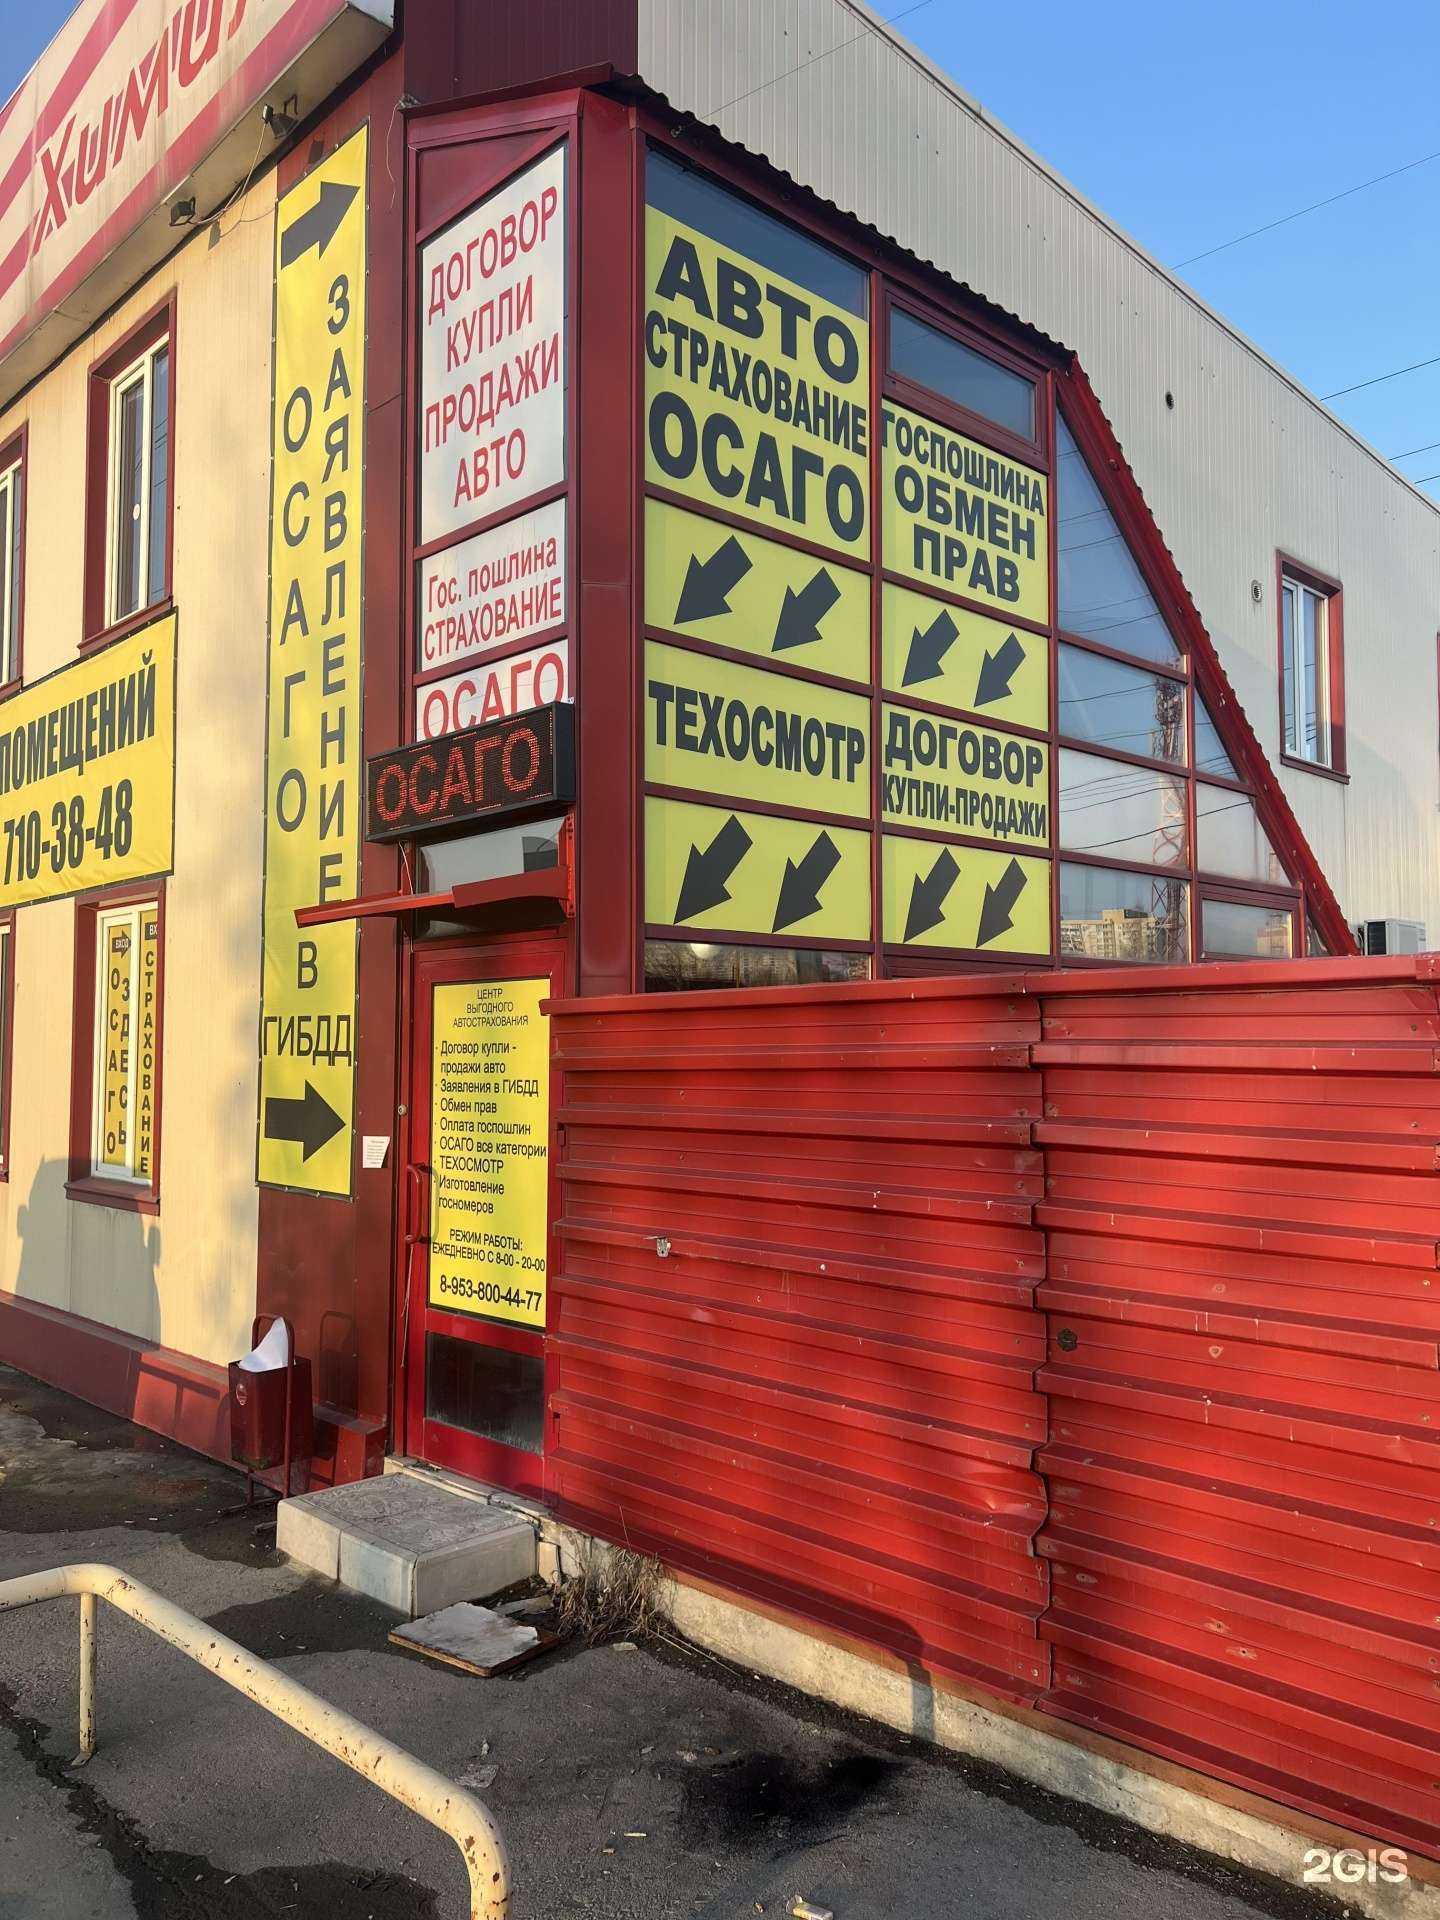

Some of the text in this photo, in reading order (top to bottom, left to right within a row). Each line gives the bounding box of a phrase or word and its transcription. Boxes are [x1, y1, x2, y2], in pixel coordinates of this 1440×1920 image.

[428, 186, 558, 325] ДОГОВОР
[446, 275, 533, 372] КУПЛИ
[654, 235, 859, 385] АВТО
[425, 332, 560, 453] ПРОДАЖИ
[645, 310, 867, 457] СТРАХОВАНИЕ
[454, 428, 526, 507] АВТО
[648, 391, 864, 542] ОСАГО
[881, 408, 1045, 516] ГОСПОШЛИНА
[894, 464, 1036, 560] ОБМЕН
[428, 536, 557, 613] Гос. пошлина
[913, 524, 1020, 603] ПРАВ
[276, 385, 313, 833] ОСАГО
[424, 577, 562, 661] СТРАХОВАНИЕ
[0, 650, 156, 795] ПОМЕЩЕНИЙ
[423, 653, 564, 739] ОСАГО
[648, 680, 865, 783] ТЕХОСМОТР
[376, 727, 540, 821] ОСАГО
[885, 712, 1043, 788] ДОГОВОР
[4, 778, 133, 885] 710-38-48
[882, 773, 1047, 839] КУПЛИ-ПРОДАЖИ
[298, 941, 318, 988] В
[477, 988, 503, 1000] ЦЕНТР
[264, 1015, 352, 1066] ГИБДД
[453, 1015, 528, 1028] АВТОСТРАХОВАНИЯ
[466, 1001, 514, 1014] ВЫГОДНОГО
[140, 950, 154, 1174] СТРАХОВАНИЕ
[441, 1040, 479, 1057] Договор
[481, 1042, 510, 1056] купли
[441, 1061, 506, 1077] продажи авто
[440, 1078, 539, 1097] Заявления в ГИБДД
[440, 1097, 497, 1116] Обмен прав
[439, 1136, 547, 1159] ОСАГО все категории
[440, 1117, 531, 1136] Оплата госпошлин
[440, 1155, 504, 1174] ТЕХОСМОТР
[438, 1197, 494, 1216] госномеров
[439, 1175, 505, 1195] Изготовление
[432, 1242, 486, 1261] ЕЖЕДНЕВНО
[496, 1252, 514, 1267] 8-00
[521, 1256, 545, 1272] 20-00
[450, 1229, 523, 1251] РЕЖИМ РАБОТЫ:
[440, 1274, 543, 1312] 8-953-800-44-77
